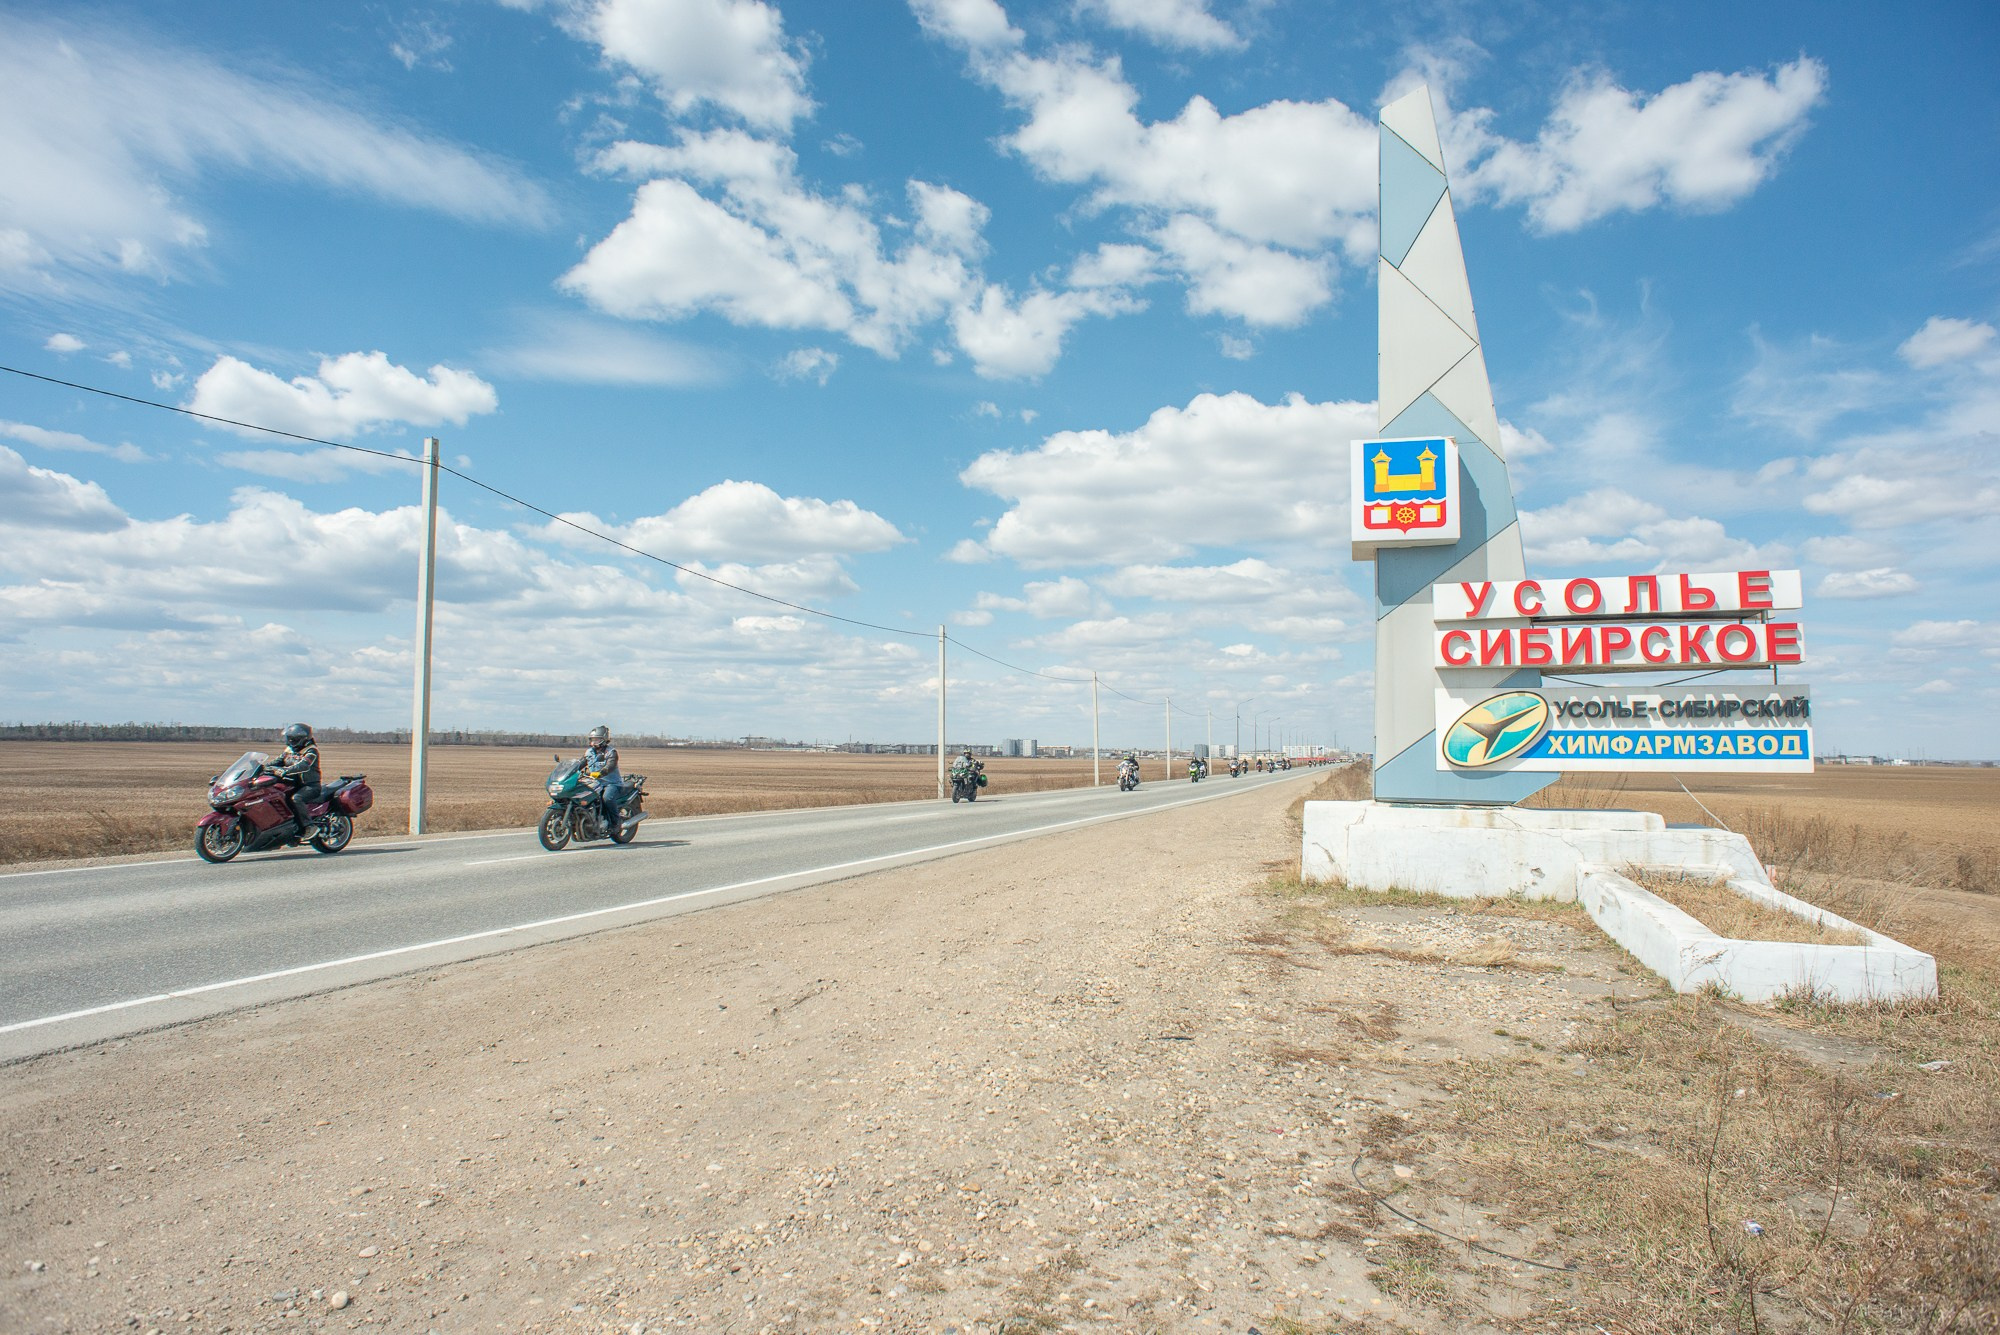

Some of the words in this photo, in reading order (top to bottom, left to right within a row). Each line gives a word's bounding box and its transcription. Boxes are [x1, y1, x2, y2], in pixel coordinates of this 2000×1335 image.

[1461, 570, 1773, 618] УСОЛЬЕ
[1441, 622, 1801, 666] СИБИРСКОЕ
[1553, 696, 1810, 719] УСОЛЬЕ-СИБИРСКИЙ
[1548, 735, 1803, 755] ХИМФАРМЗАВОД
